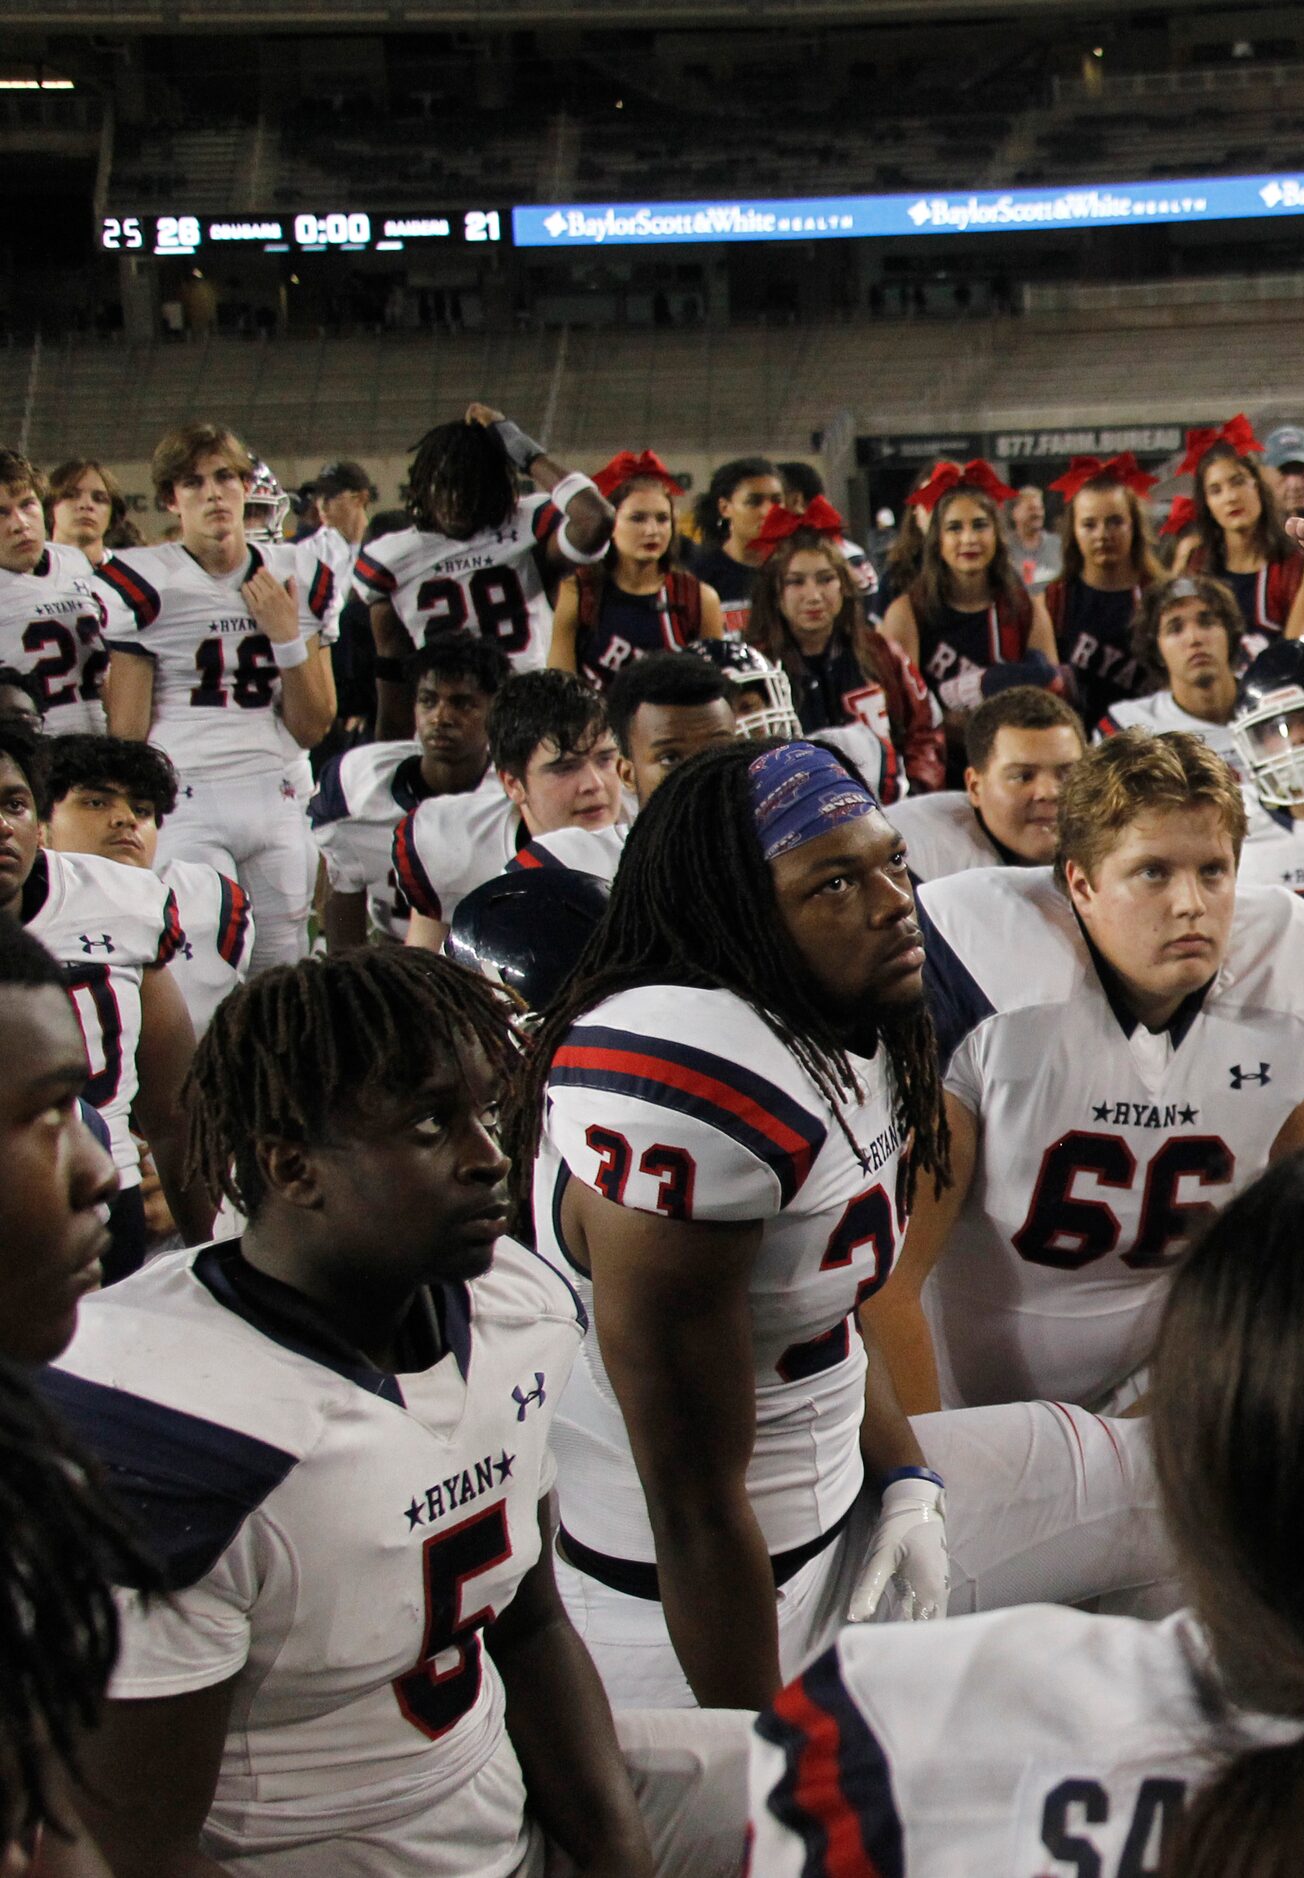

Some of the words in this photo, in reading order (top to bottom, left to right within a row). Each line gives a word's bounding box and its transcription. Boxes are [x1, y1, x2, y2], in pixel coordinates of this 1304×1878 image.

[1132, 197, 1207, 216] HEALTH
[103, 218, 143, 248] 25
[295, 213, 371, 244] 0:00
[464, 210, 501, 241] 21
[778, 214, 853, 232] HEALTH
[445, 556, 484, 574] RYAN
[417, 564, 531, 654] 28
[1112, 1102, 1177, 1129] RYAN
[1011, 1129, 1236, 1271] 66
[425, 1456, 495, 1523] RYAN
[391, 1496, 514, 1743] 5
